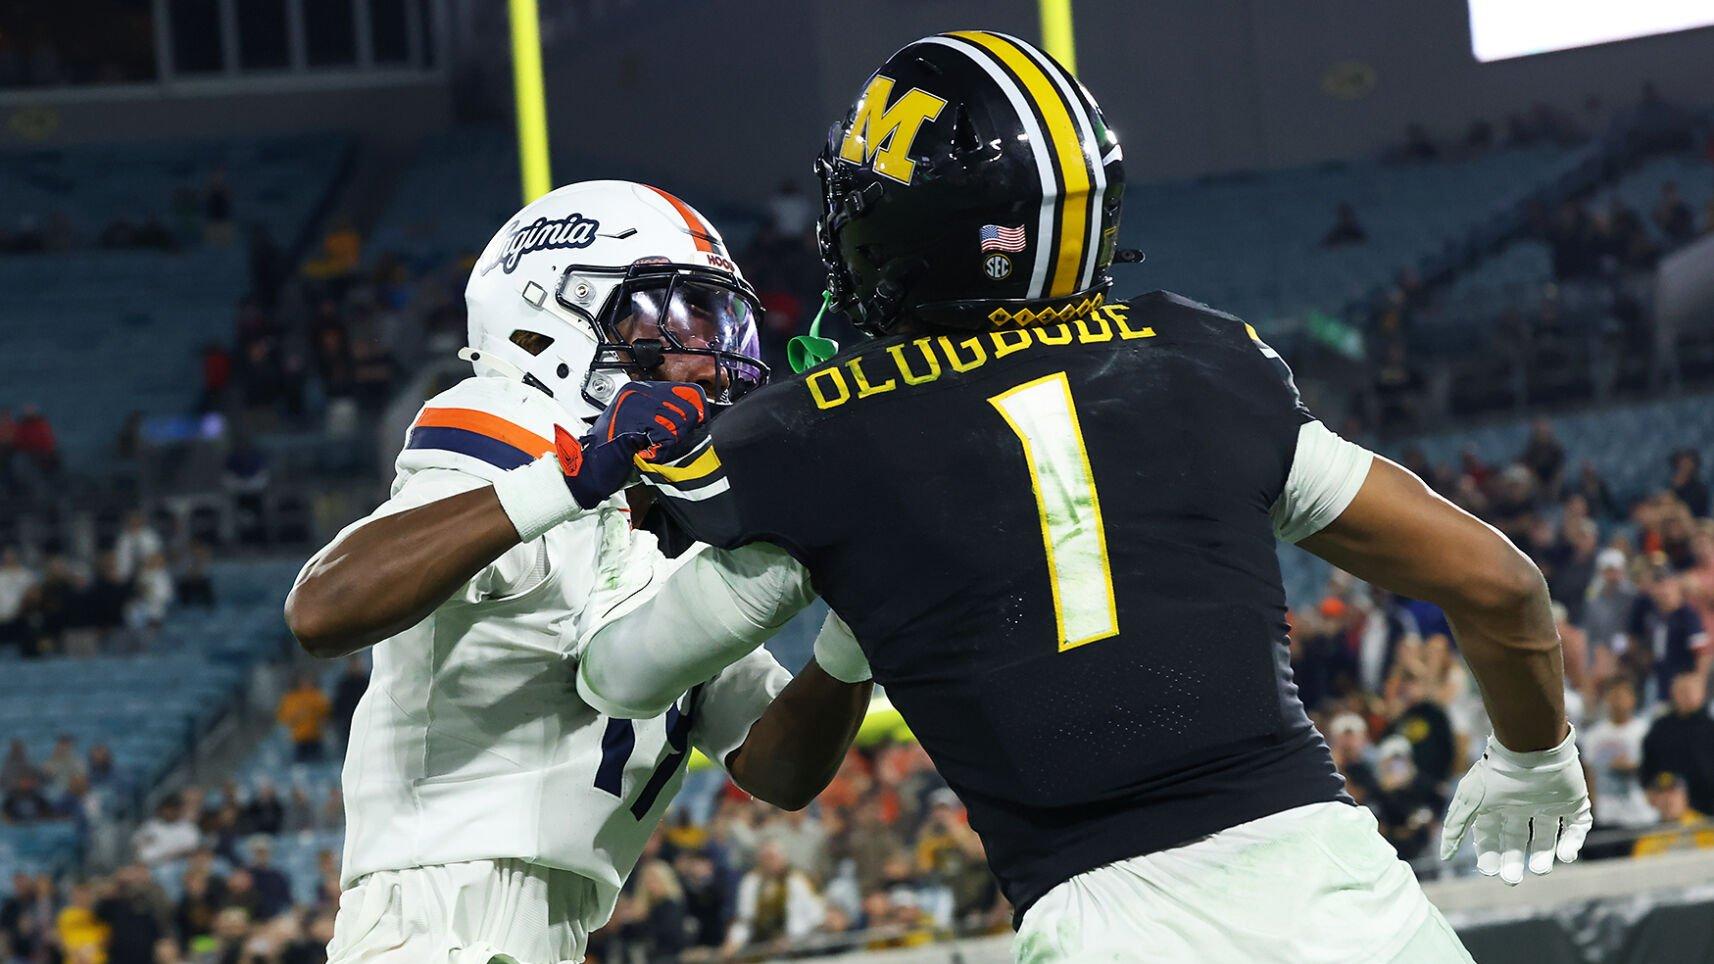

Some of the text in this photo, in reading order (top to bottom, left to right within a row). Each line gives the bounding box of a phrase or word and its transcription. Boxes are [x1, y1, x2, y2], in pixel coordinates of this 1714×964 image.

[839, 75, 948, 187] M
[481, 212, 600, 275] rginia
[986, 256, 1009, 278] SEC
[986, 371, 1120, 653] 1
